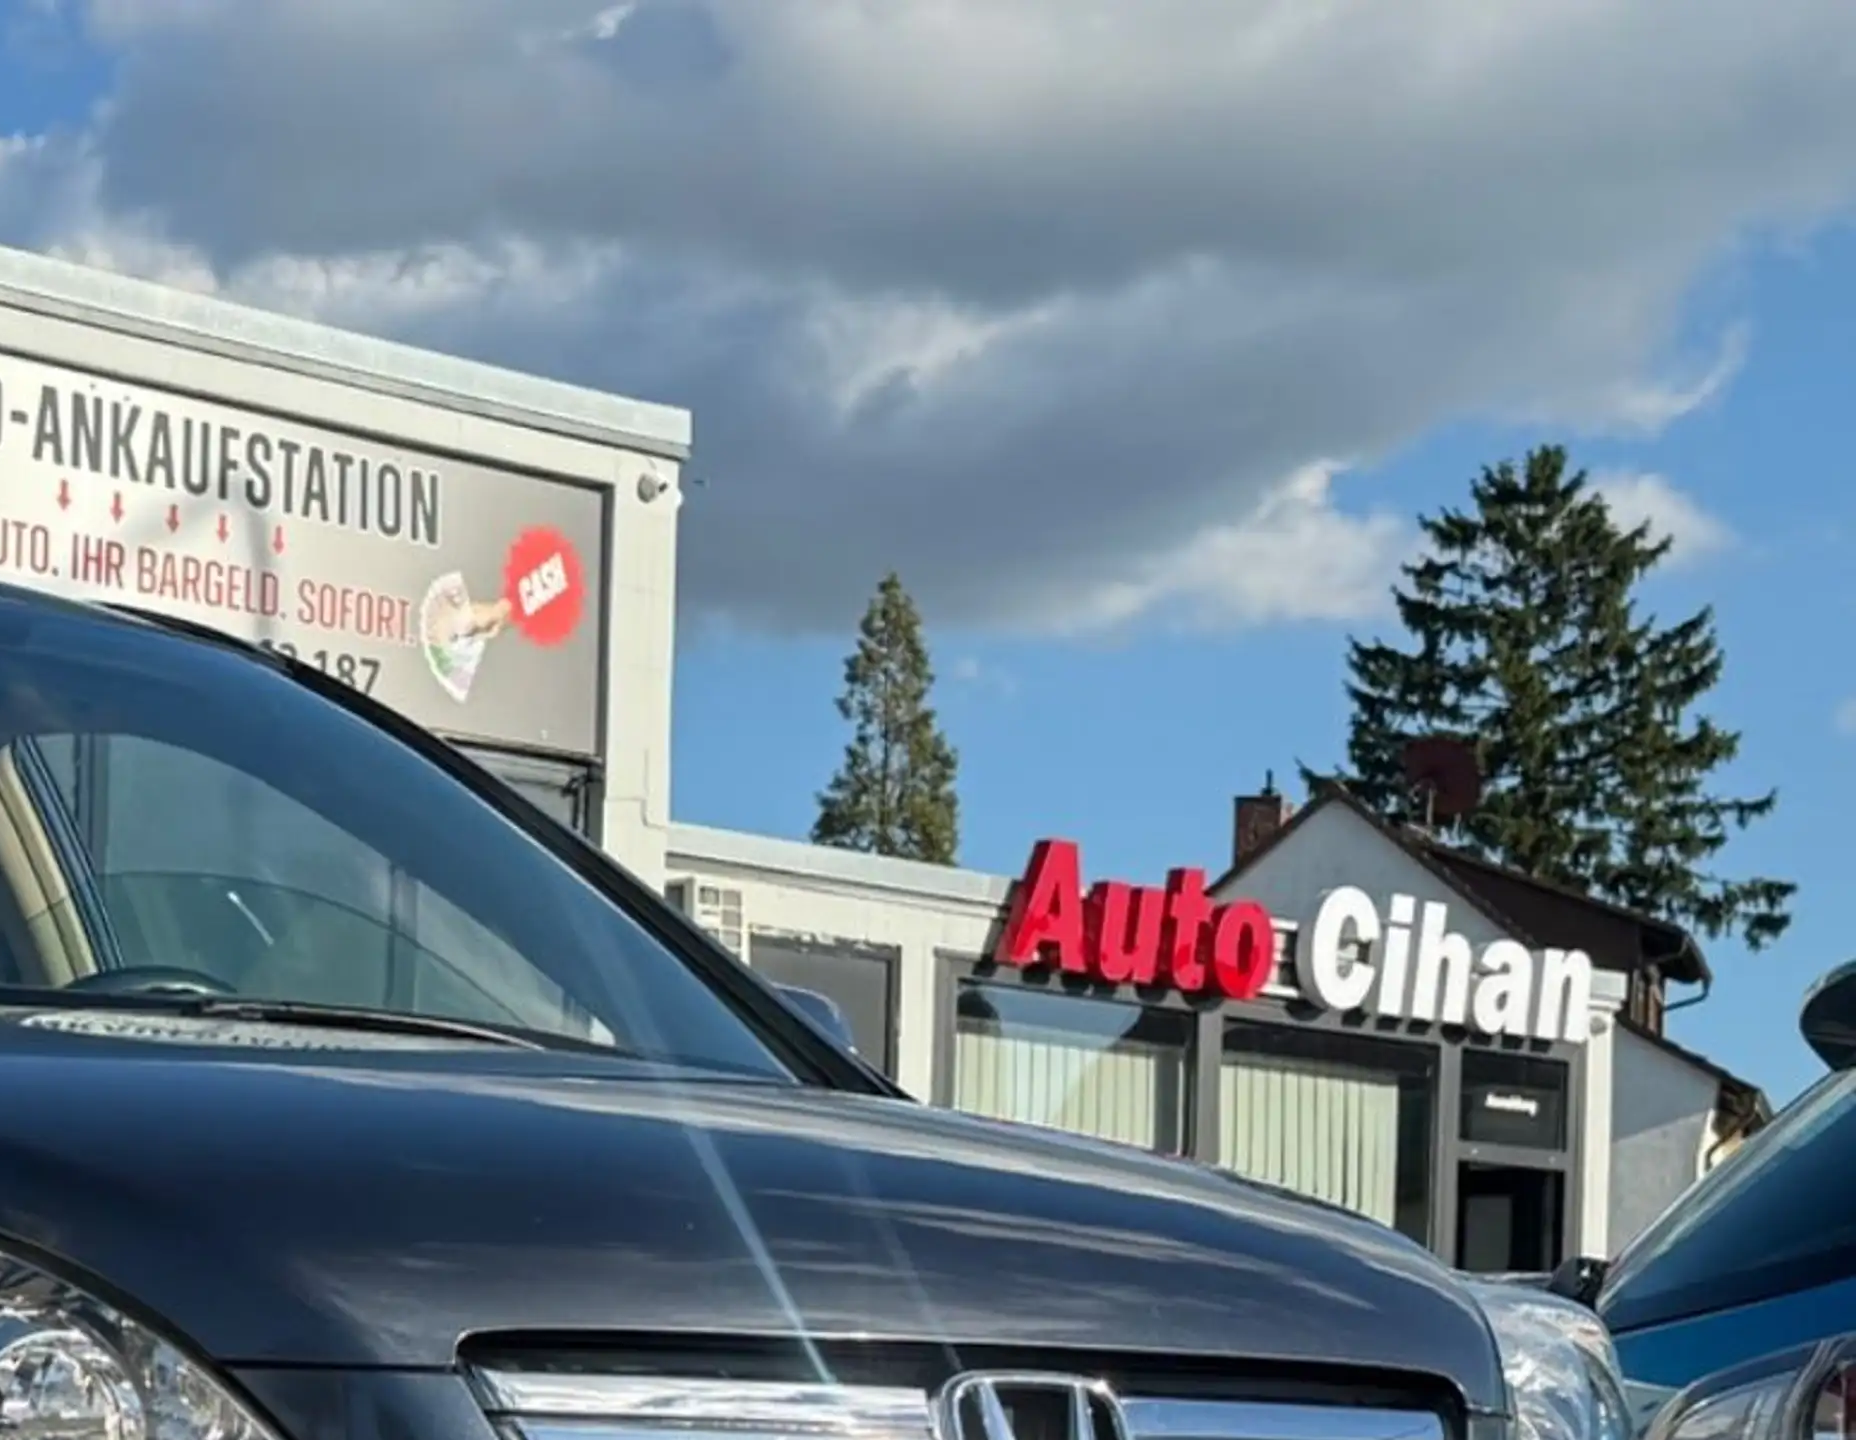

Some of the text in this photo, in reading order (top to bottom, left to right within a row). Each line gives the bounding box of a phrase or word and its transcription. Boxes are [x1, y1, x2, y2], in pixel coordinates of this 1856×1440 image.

[71, 532, 125, 590] IHR
[137, 546, 287, 620] BARGELD.
[297, 578, 418, 645] SOFORT.
[998, 838, 1594, 1045] Auto Cihan
